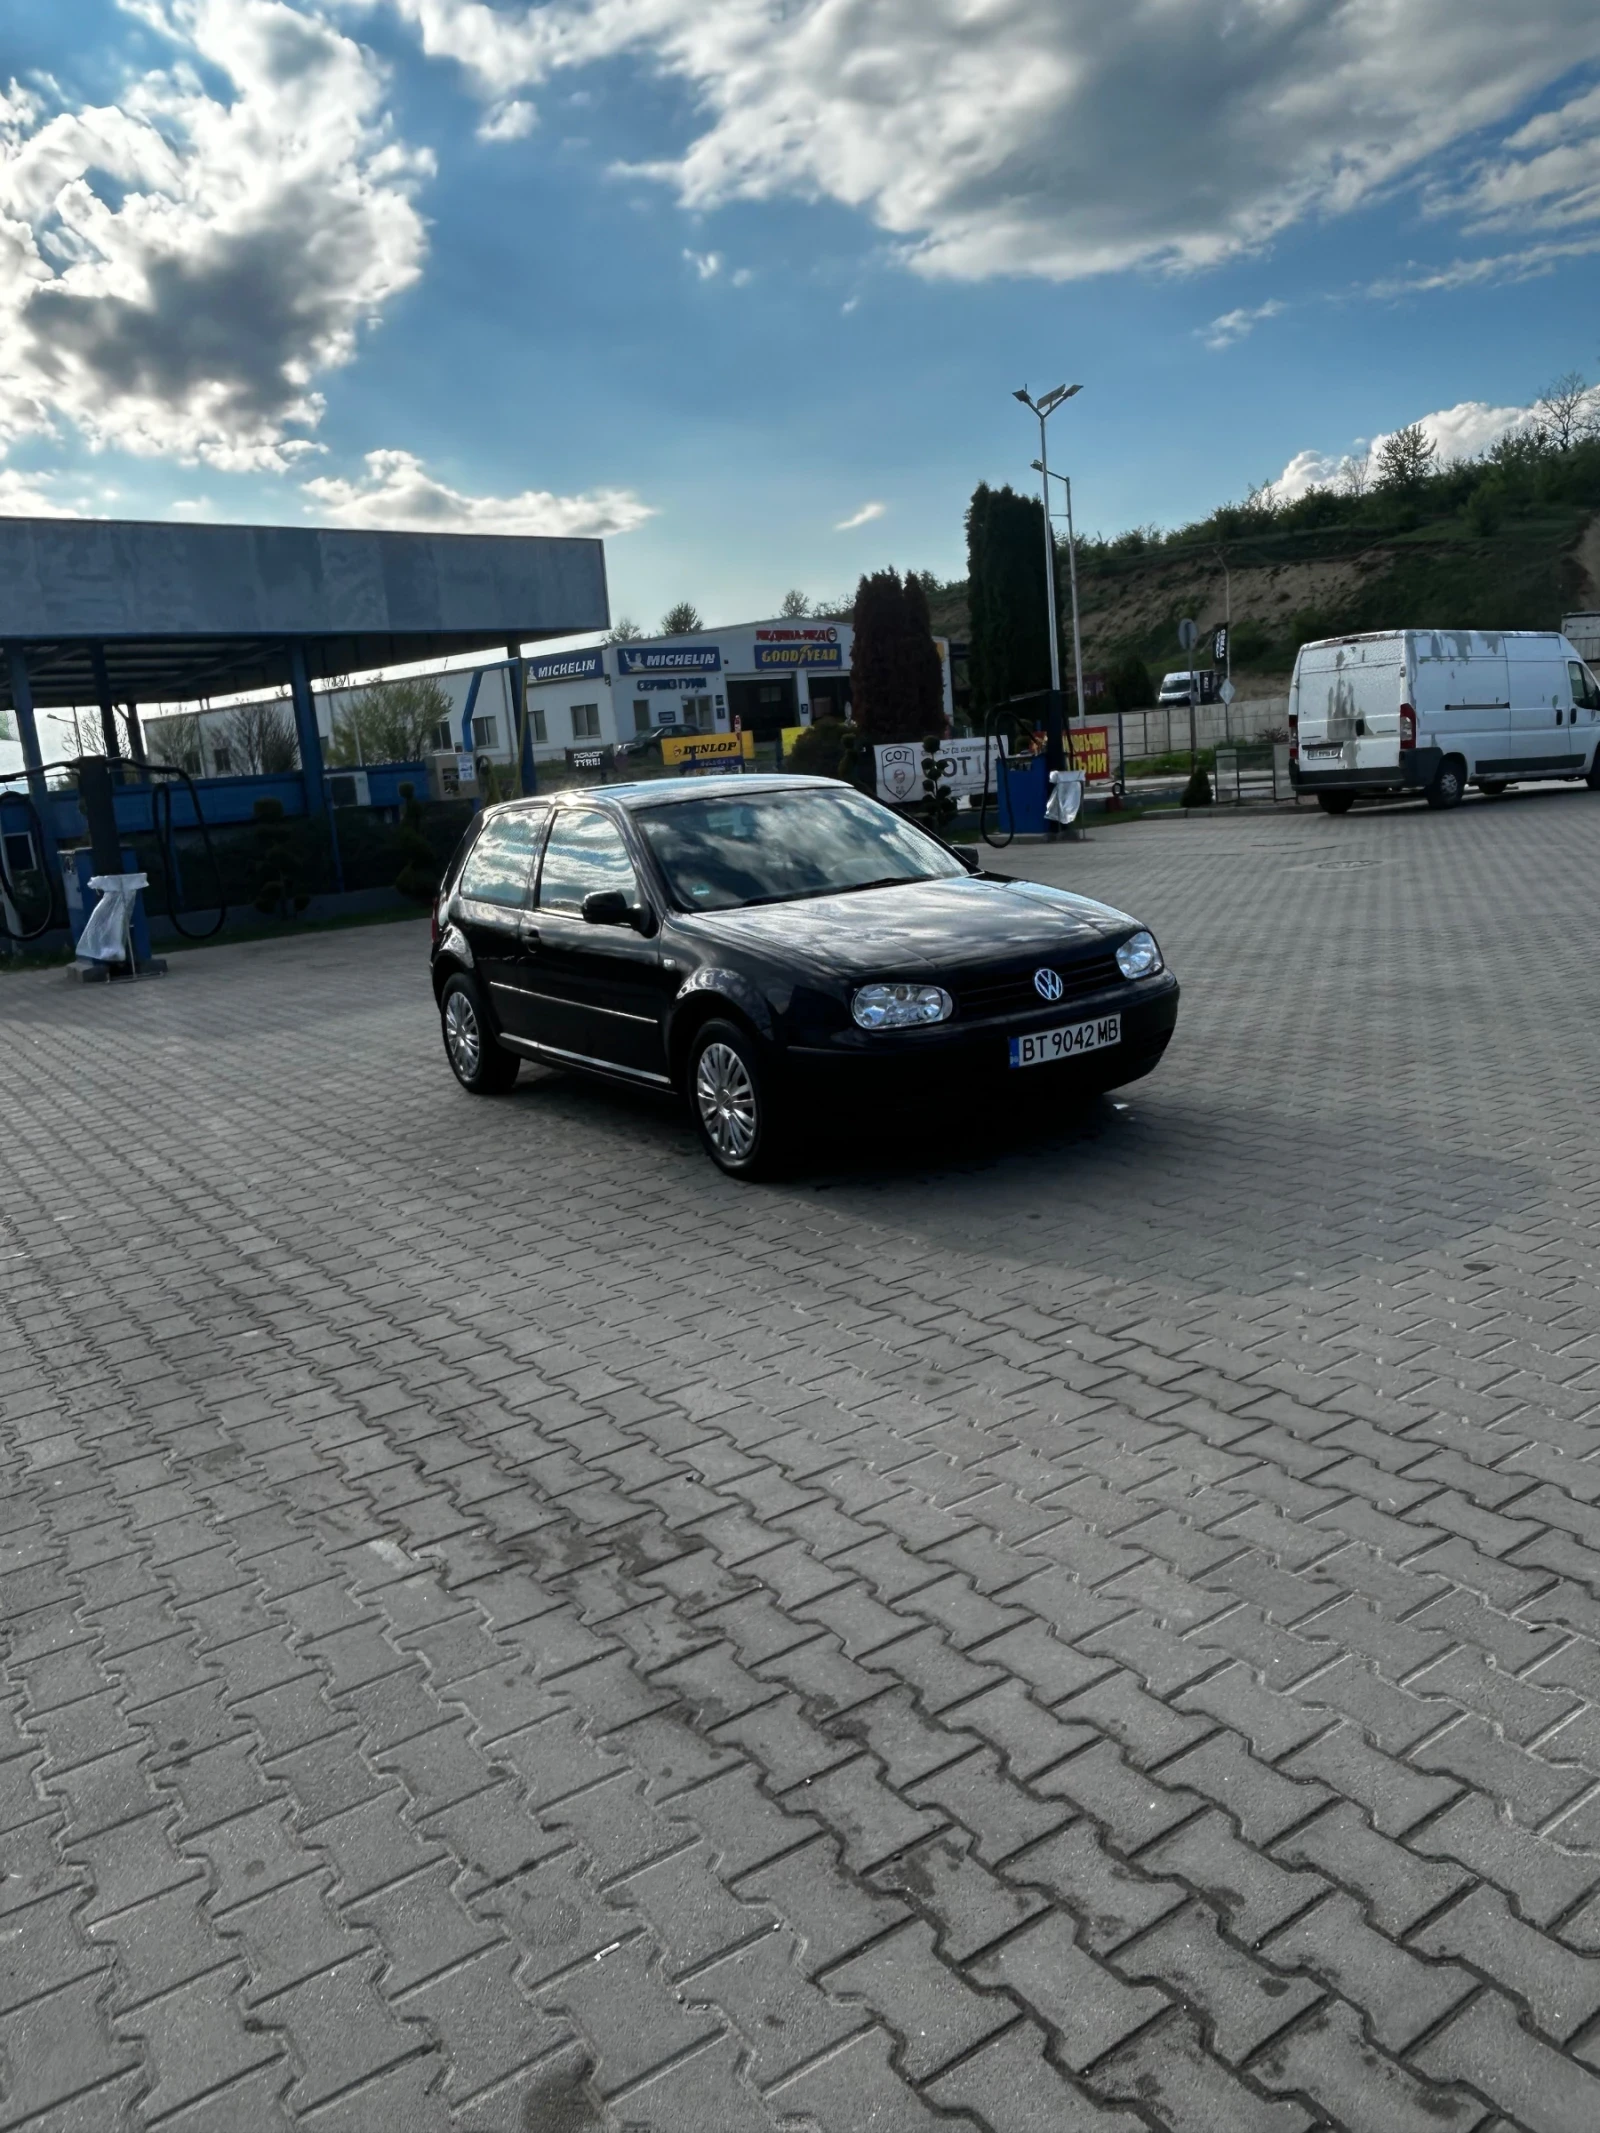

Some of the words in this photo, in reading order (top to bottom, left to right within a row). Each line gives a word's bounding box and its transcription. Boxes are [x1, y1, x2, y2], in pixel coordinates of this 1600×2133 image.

[646, 653, 715, 666] MICHELIN
[761, 645, 837, 664] GOODYEAR
[538, 659, 596, 678] MICHELIN
[683, 742, 736, 755] DUNLOP
[1022, 1035, 1048, 1062] BT
[1052, 1024, 1094, 1056] 9042
[1097, 1018, 1118, 1045] MB
